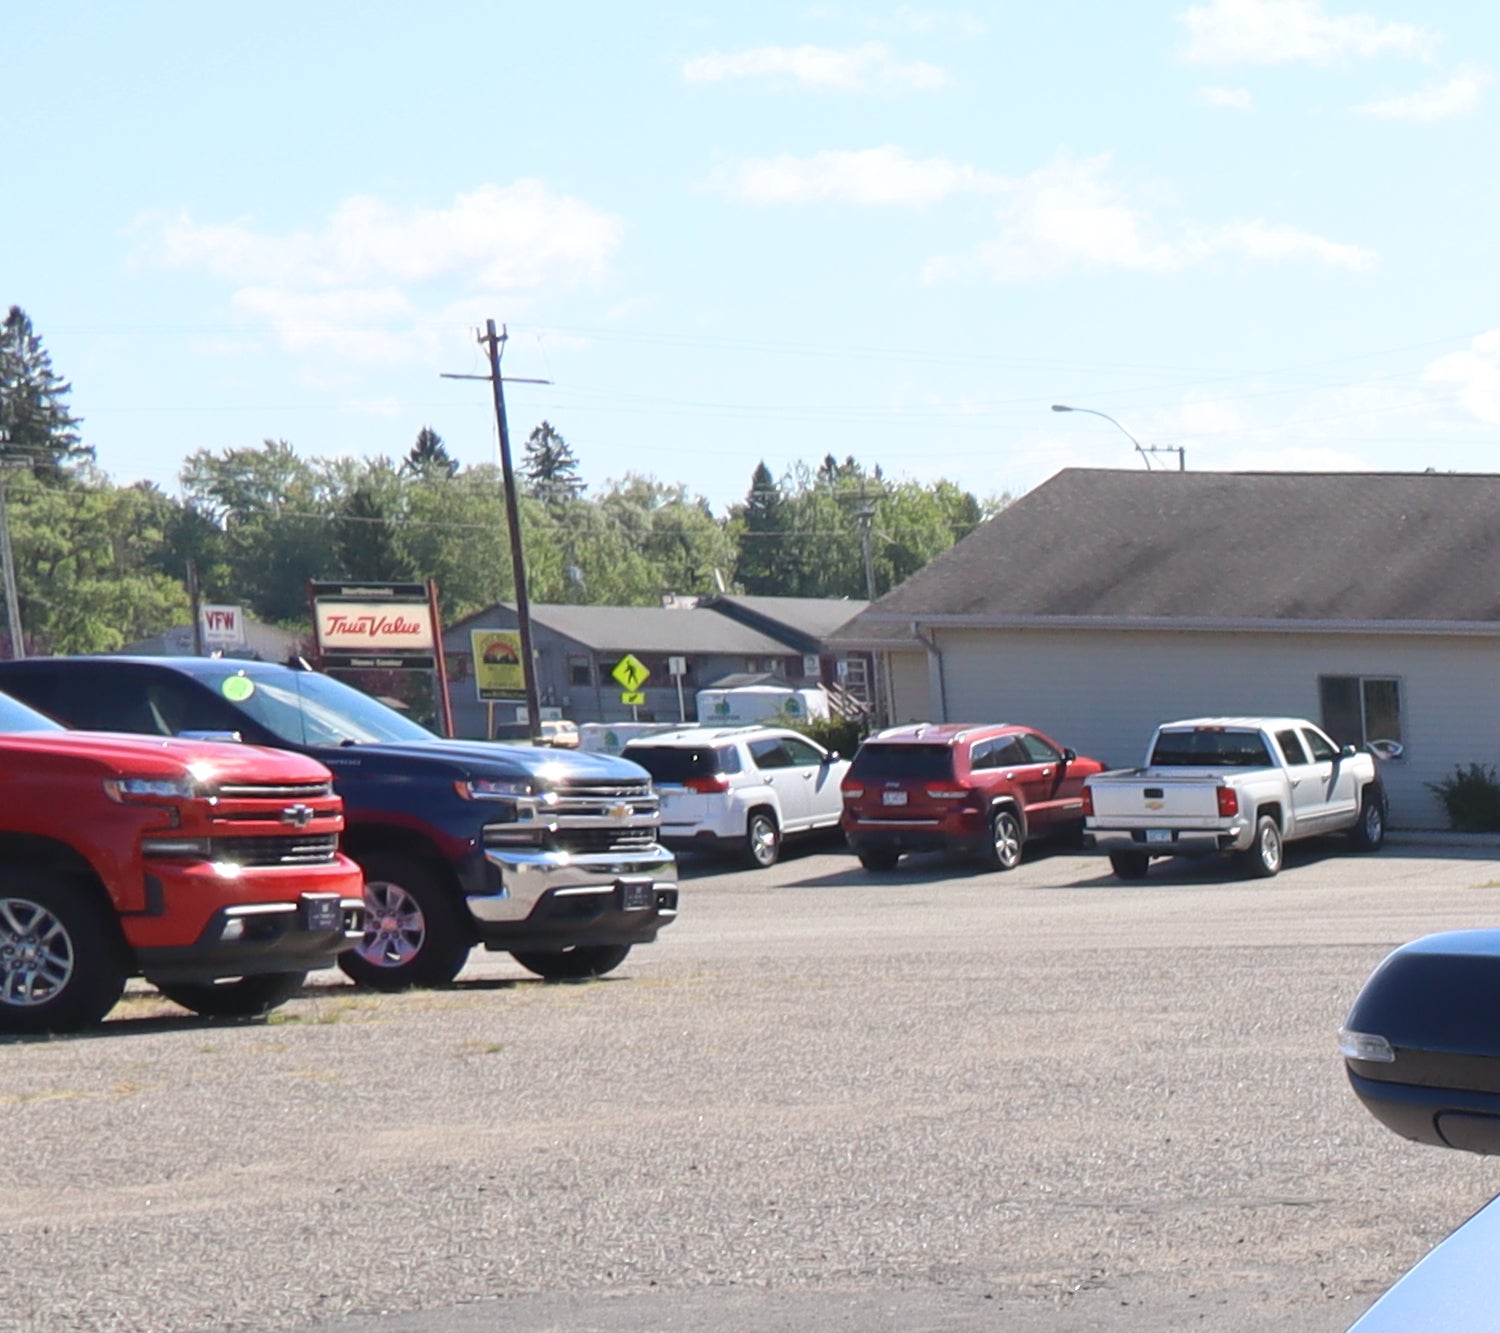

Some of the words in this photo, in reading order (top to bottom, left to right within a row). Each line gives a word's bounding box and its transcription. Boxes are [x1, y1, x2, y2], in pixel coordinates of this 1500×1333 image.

[205, 611, 234, 630] VFW
[324, 616, 367, 636] True
[358, 616, 421, 637] Value
